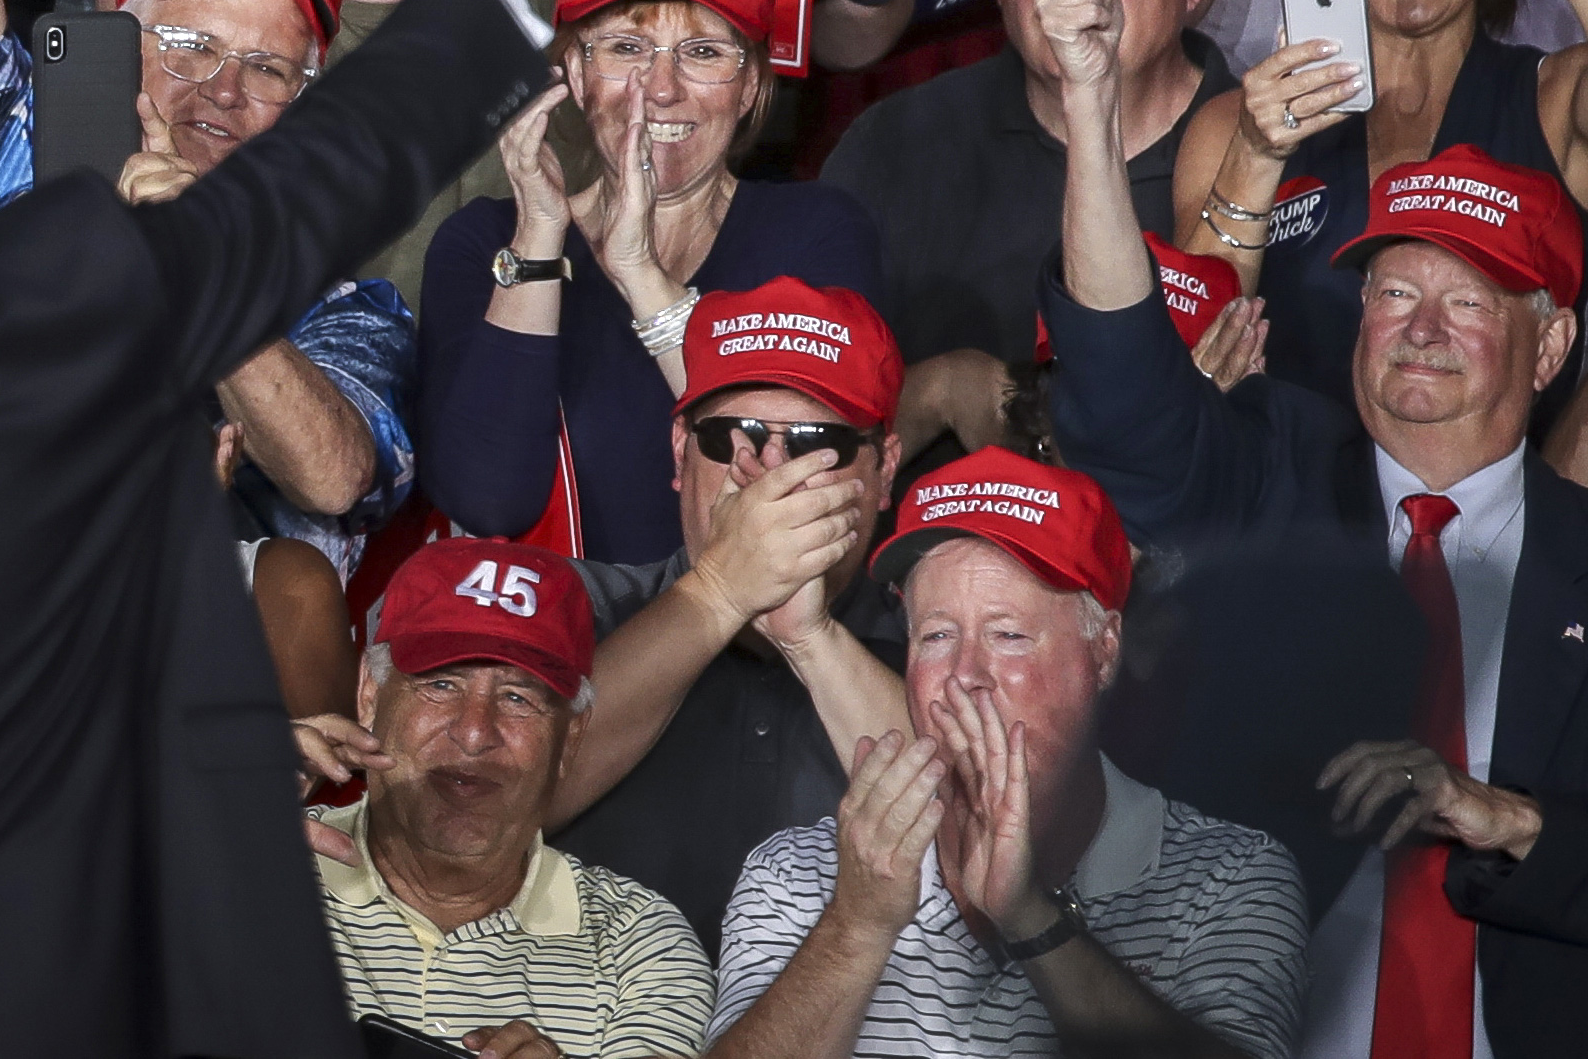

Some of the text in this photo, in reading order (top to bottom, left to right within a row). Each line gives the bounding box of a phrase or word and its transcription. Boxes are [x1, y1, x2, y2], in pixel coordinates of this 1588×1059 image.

[1386, 174, 1520, 213] MAKE AMERICA
[1388, 195, 1507, 228] GREAT AGAIN
[1159, 265, 1210, 300] ERICA
[1164, 288, 1199, 316] AIN
[711, 312, 852, 346] MAKE AMERICA
[719, 334, 841, 363] GREAT AGAIN
[915, 482, 1060, 509] MAKE AMERICA
[921, 500, 1045, 525] GREAT AGAIN
[455, 560, 541, 618] 45
